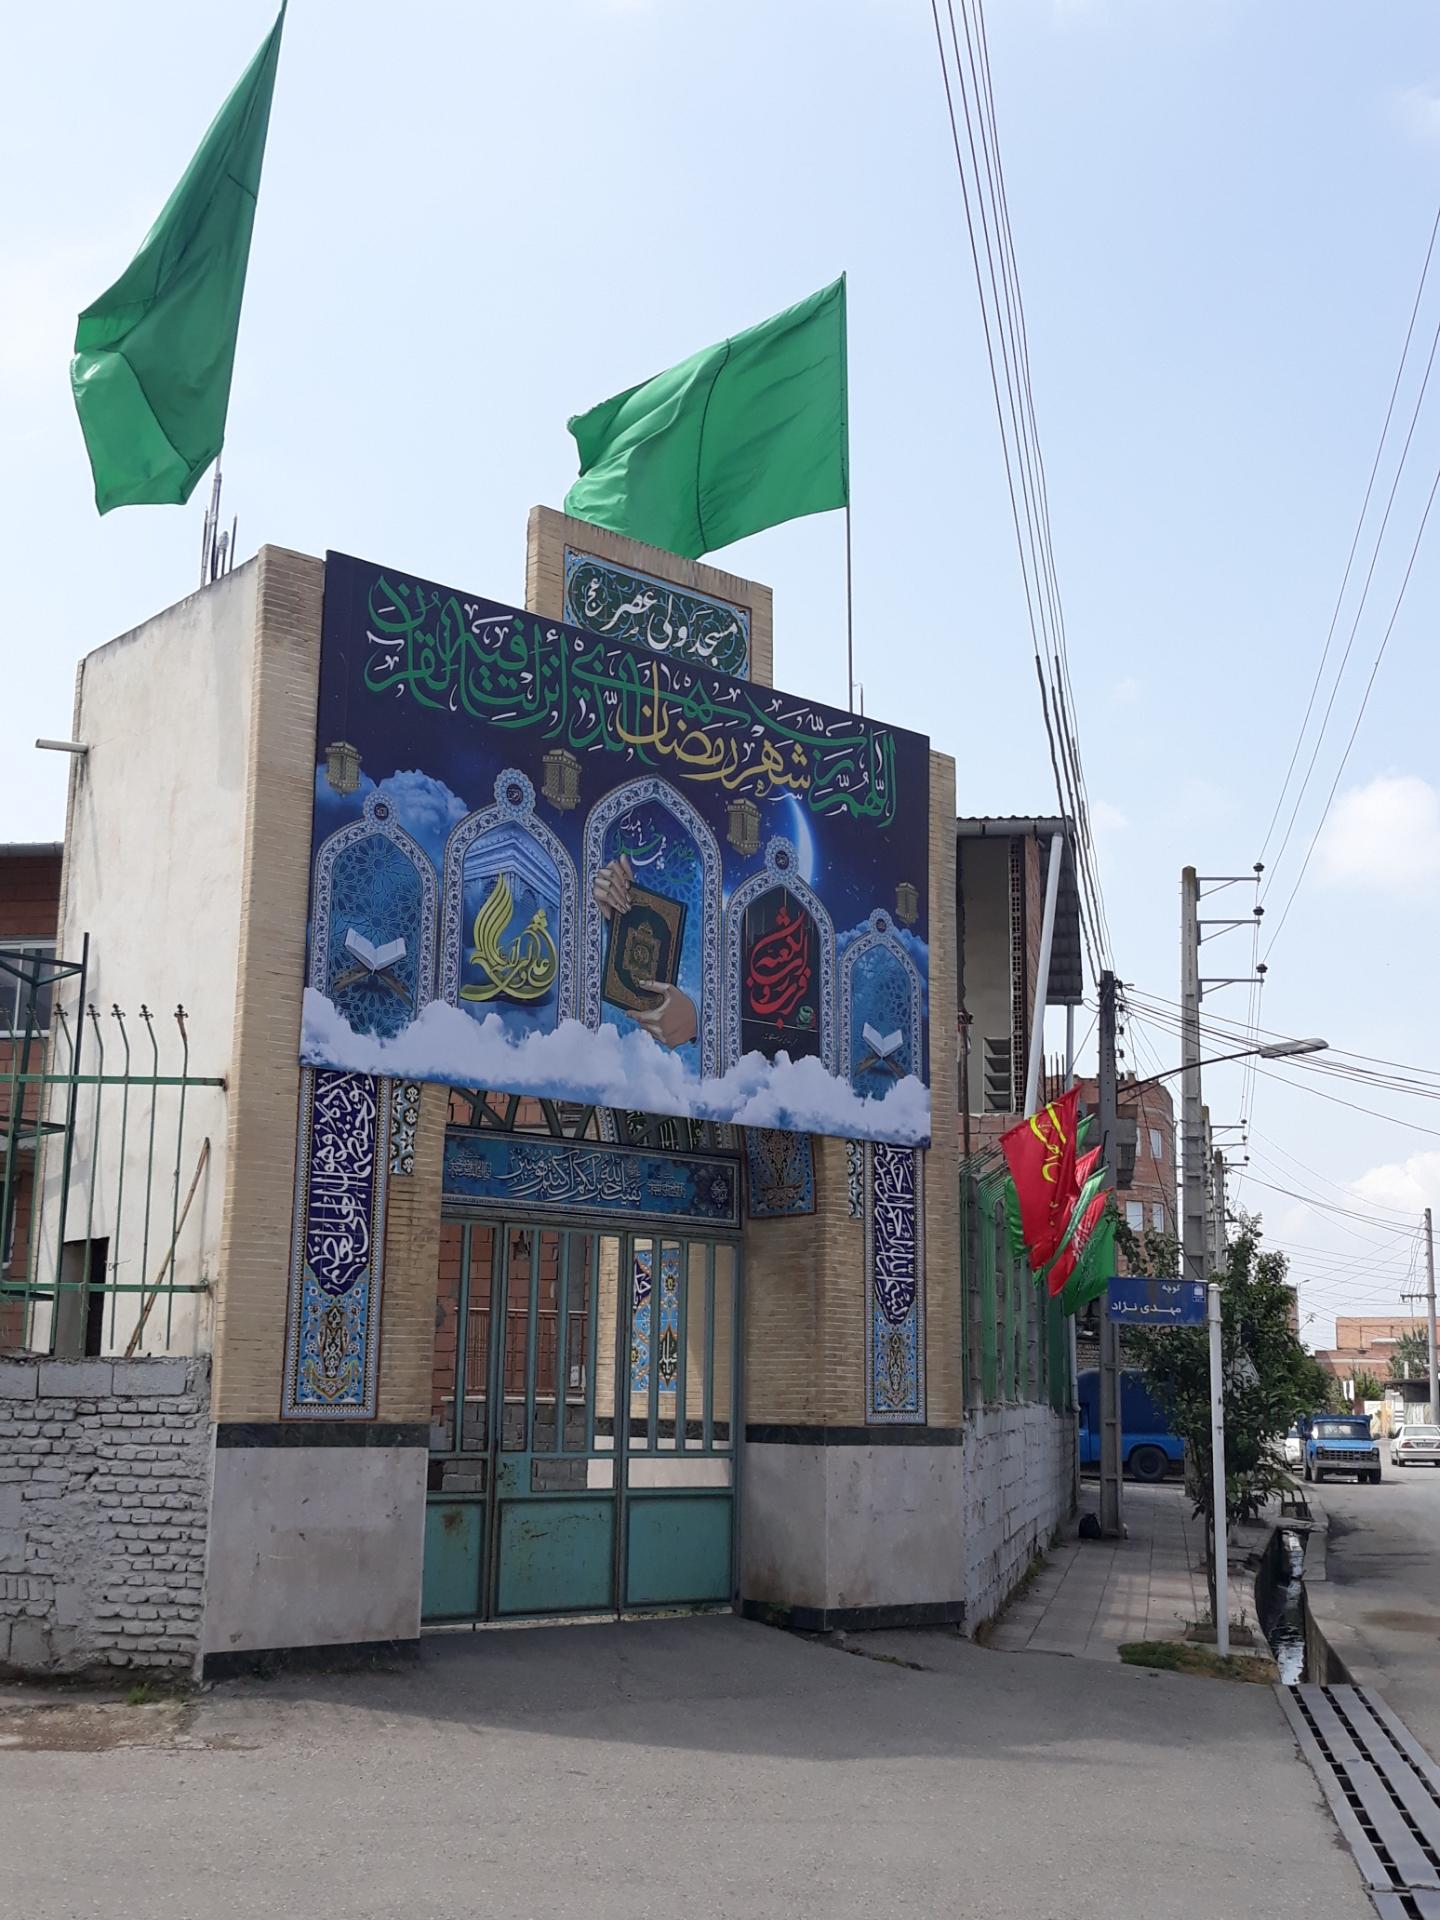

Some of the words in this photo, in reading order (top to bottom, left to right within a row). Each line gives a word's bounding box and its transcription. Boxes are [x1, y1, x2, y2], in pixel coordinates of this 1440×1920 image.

[584, 578, 604, 617] عج
[600, 591, 658, 632] عصر
[647, 594, 688, 650] ولی
[688, 622, 738, 667] مسجد
[616, 660, 739, 783] رمضان
[721, 738, 811, 791] شهر
[1111, 1301, 1137, 1313] نژاد
[1140, 1303, 1182, 1316] مهدی
[1161, 1284, 1181, 1294] کوچه
